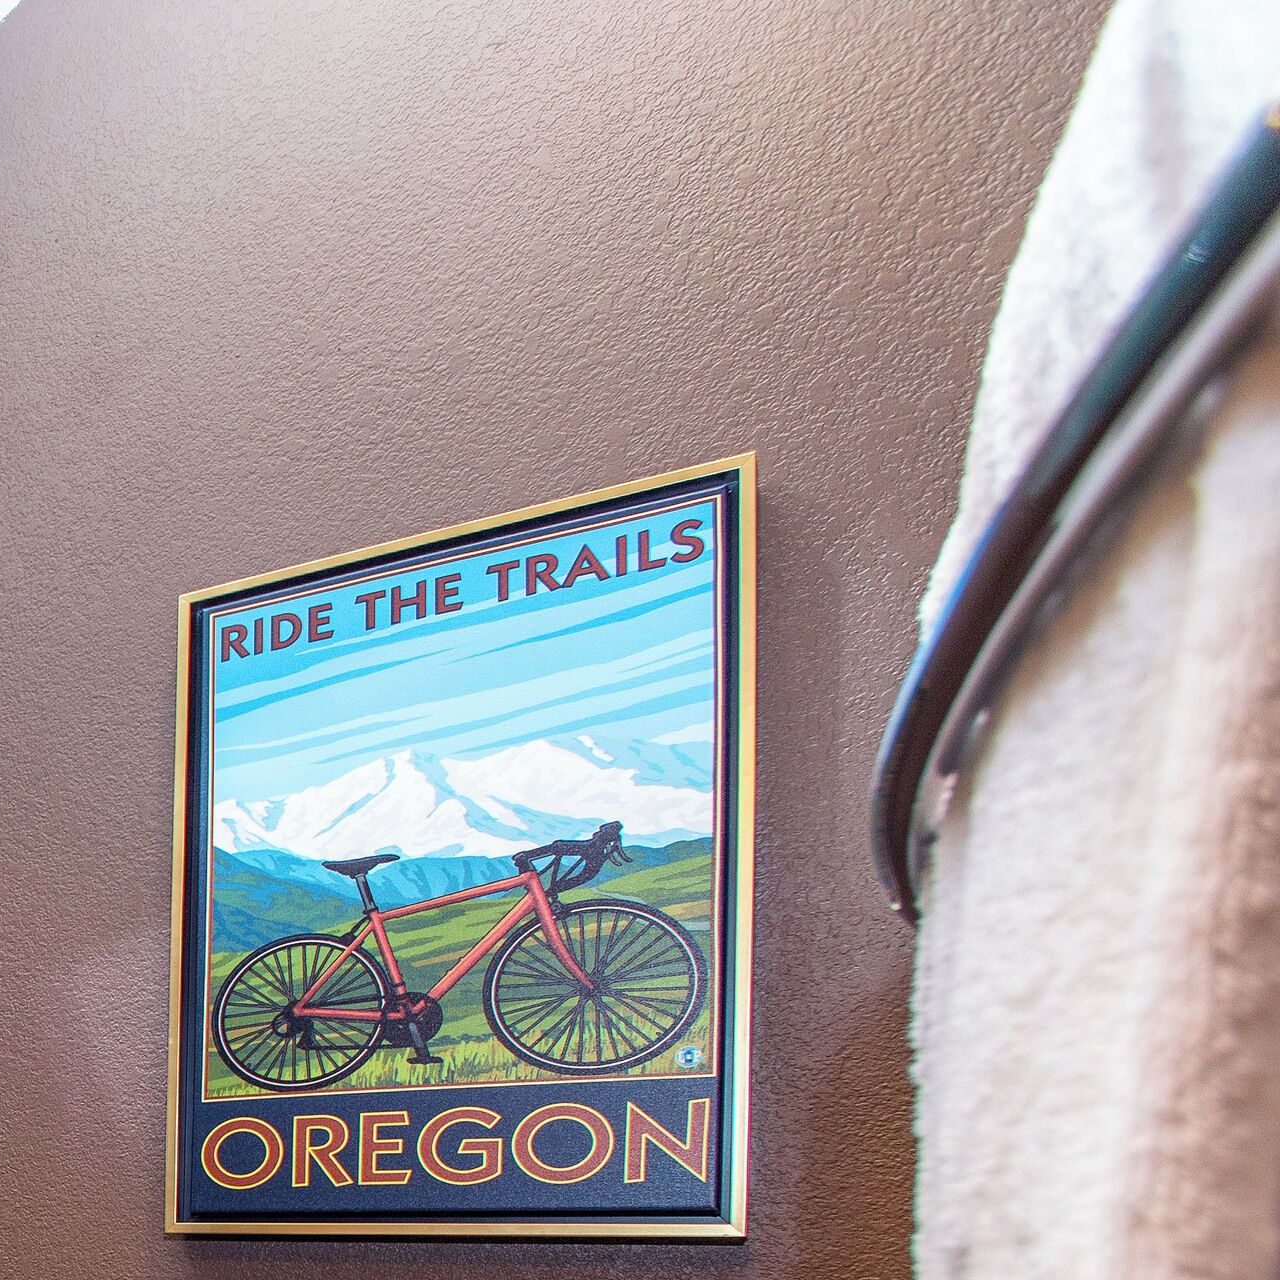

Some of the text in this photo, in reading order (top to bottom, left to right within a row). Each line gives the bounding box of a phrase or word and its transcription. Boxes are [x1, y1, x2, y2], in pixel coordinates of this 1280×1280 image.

[220, 518, 705, 663] RIDE THE TRAILS
[200, 1097, 712, 1189] OREGON
